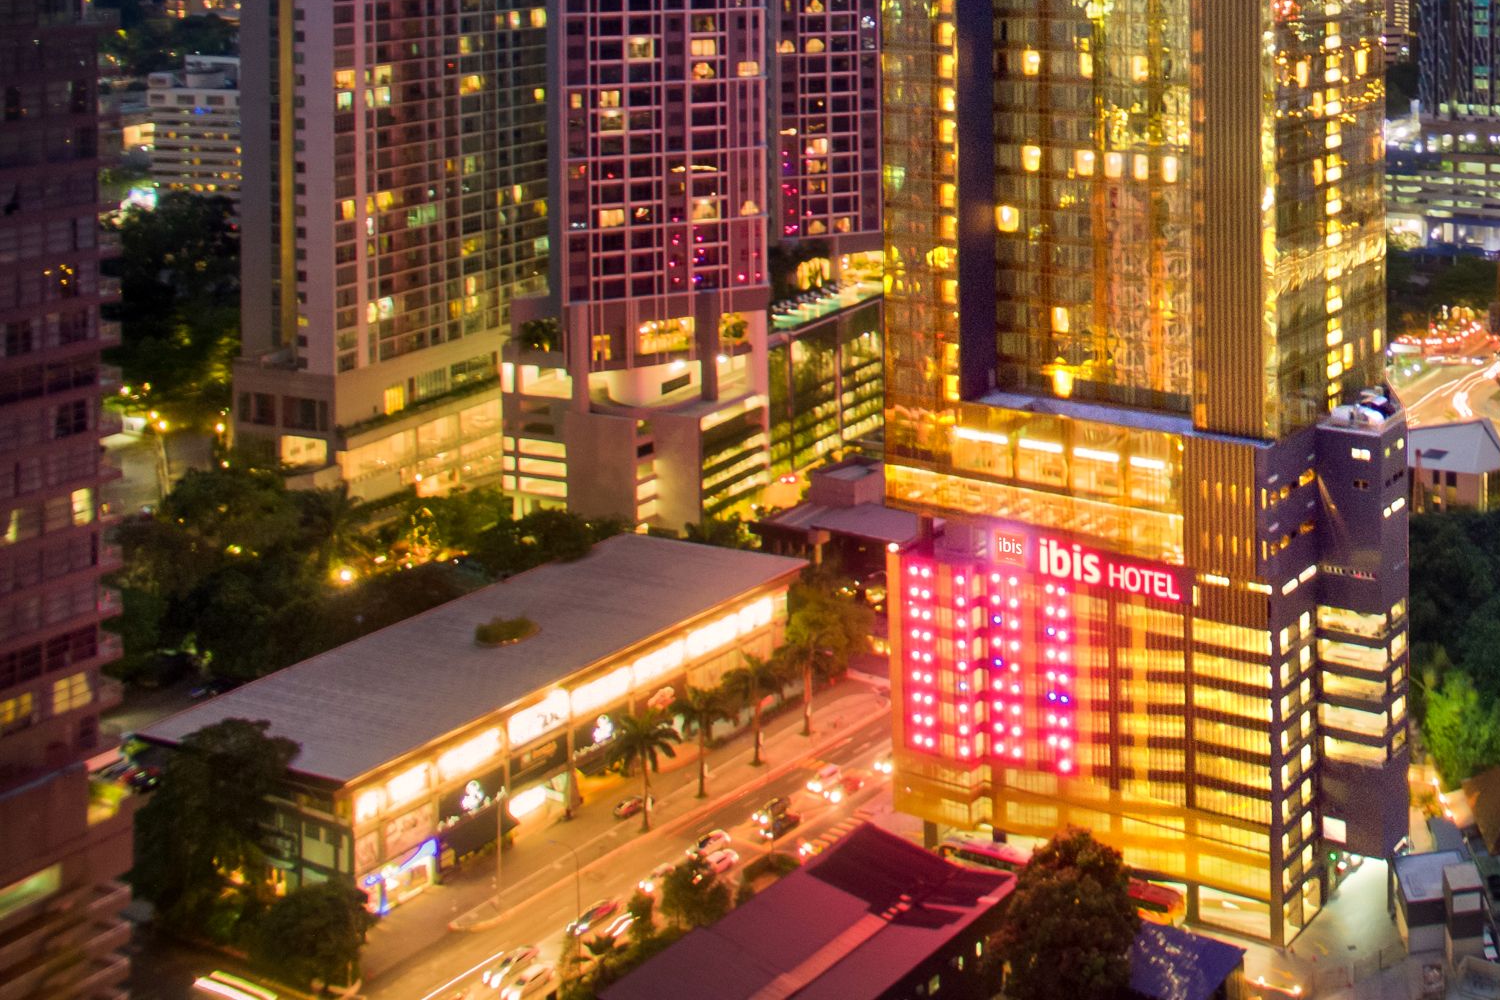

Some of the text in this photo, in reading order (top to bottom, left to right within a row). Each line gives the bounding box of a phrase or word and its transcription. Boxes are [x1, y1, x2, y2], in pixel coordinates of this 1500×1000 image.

[998, 537, 1023, 555] ibis
[1039, 538, 1180, 600] ibis HOTEL
